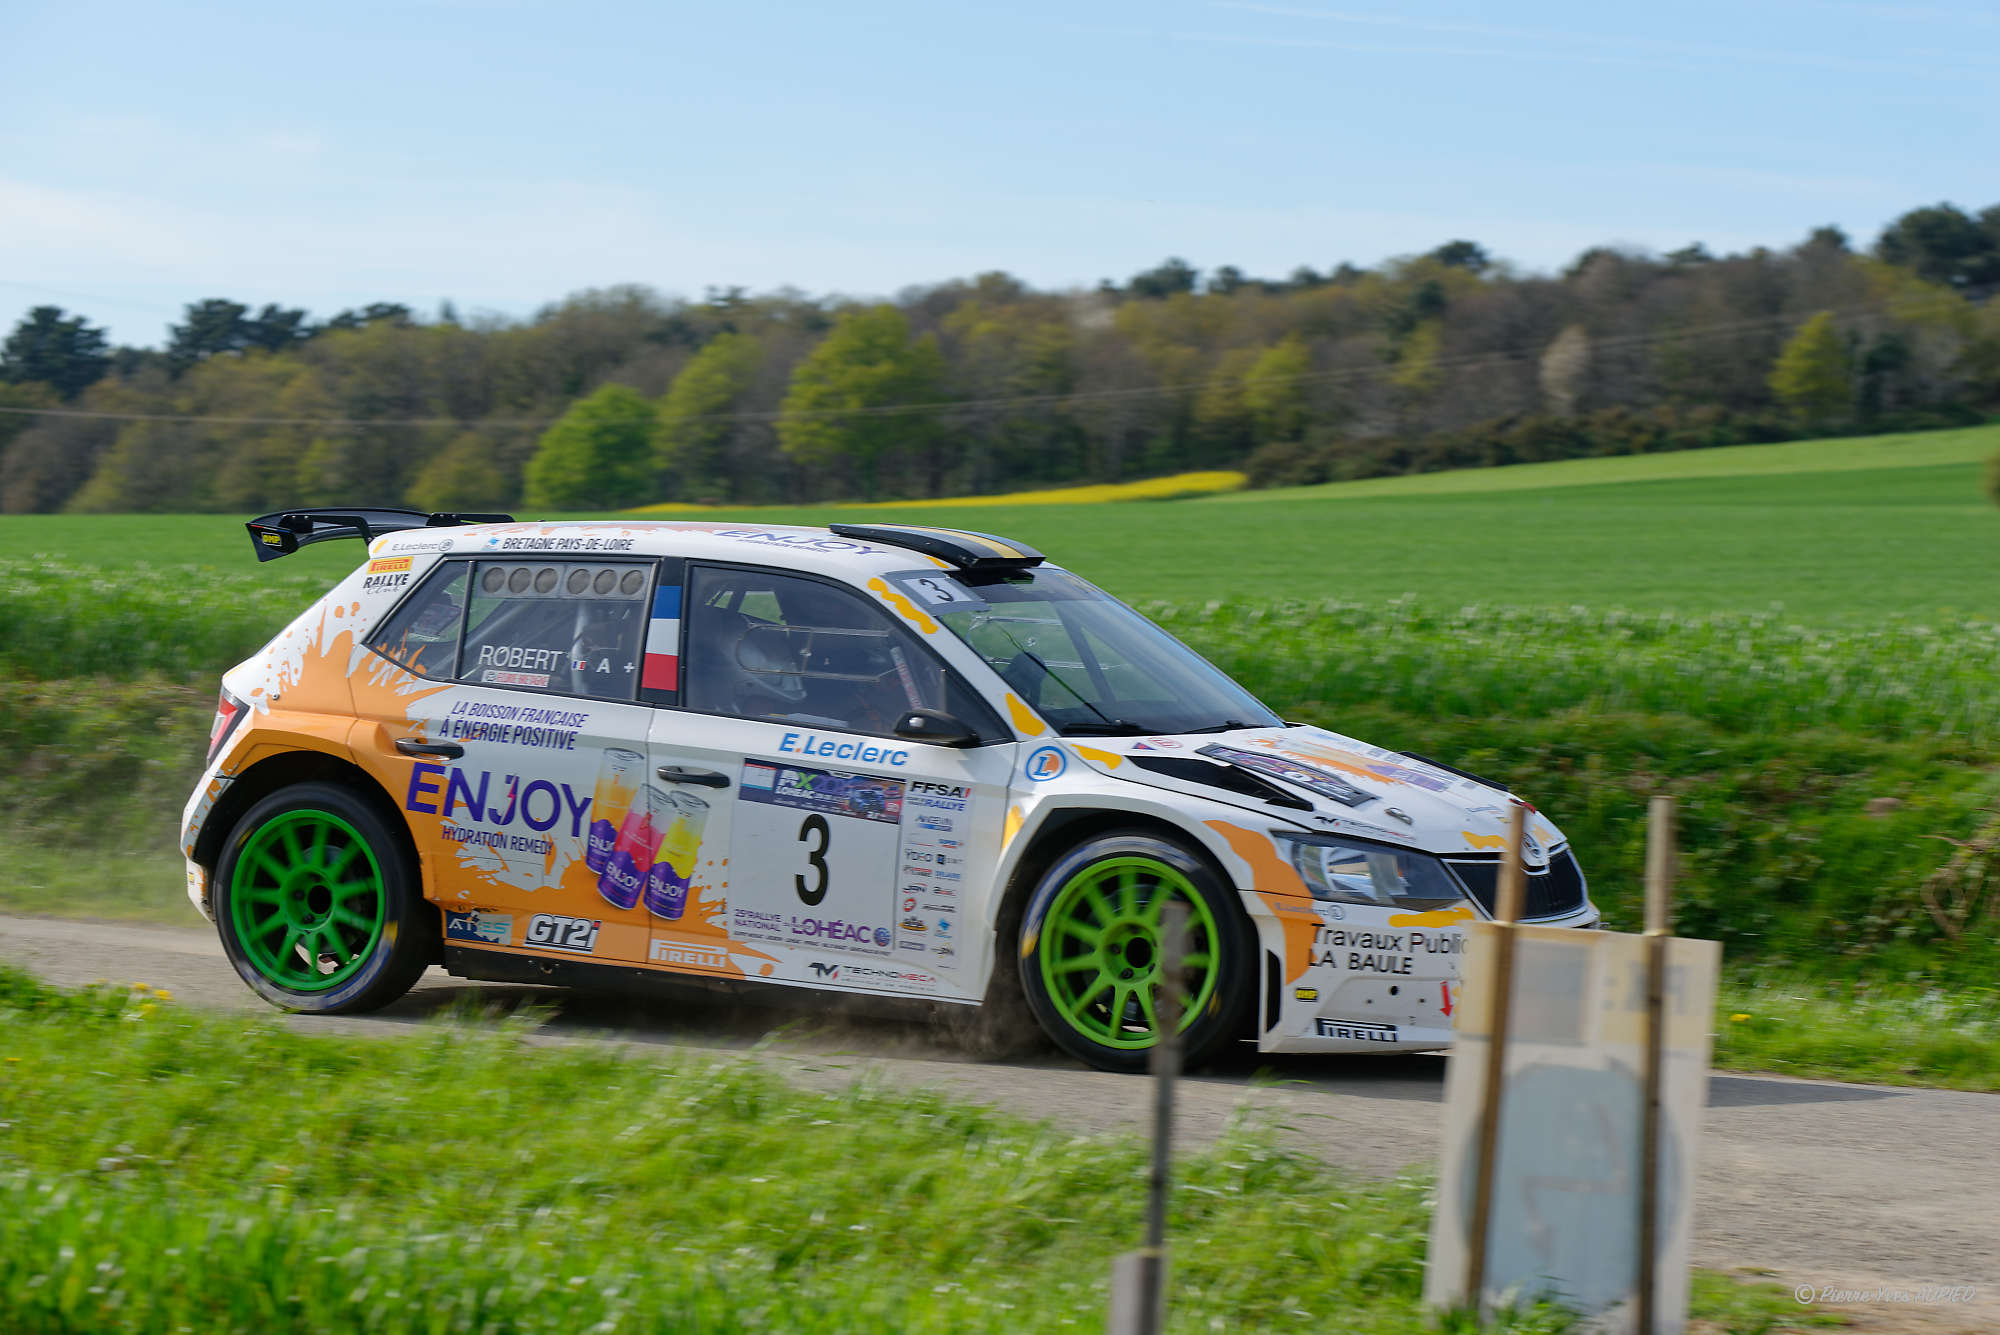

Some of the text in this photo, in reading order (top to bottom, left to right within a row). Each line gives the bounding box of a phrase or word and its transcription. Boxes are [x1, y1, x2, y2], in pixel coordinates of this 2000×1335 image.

[502, 537, 635, 551] BRETAGNE PAYS-DE-LOIRE
[714, 530, 887, 555] ENJOY
[371, 559, 410, 572] PIRELLI
[363, 573, 410, 589] RALLYE
[920, 578, 954, 602] 3
[479, 645, 564, 672] ROBERT
[451, 700, 466, 715] LA
[467, 703, 519, 721] BOISSON
[438, 715, 579, 750] À ÉNERGIE POSITIVE
[778, 732, 909, 766] E.Leclerc
[406, 761, 593, 838] ENJOY
[909, 781, 962, 798] FFSA
[441, 825, 553, 856] HYDRATION REMEDY
[796, 813, 829, 906] 3
[605, 861, 641, 890] ENJOY
[650, 874, 685, 898] ENJOY
[527, 914, 601, 946] GT2i
[735, 919, 782, 931] NATIONAL
[792, 914, 871, 944] LOHÉAC
[1311, 922, 1404, 951] Travaux
[651, 939, 728, 967] PIRELLI
[1308, 948, 1413, 975] LA BAULE
[1315, 1018, 1398, 1042] PIRELLI
